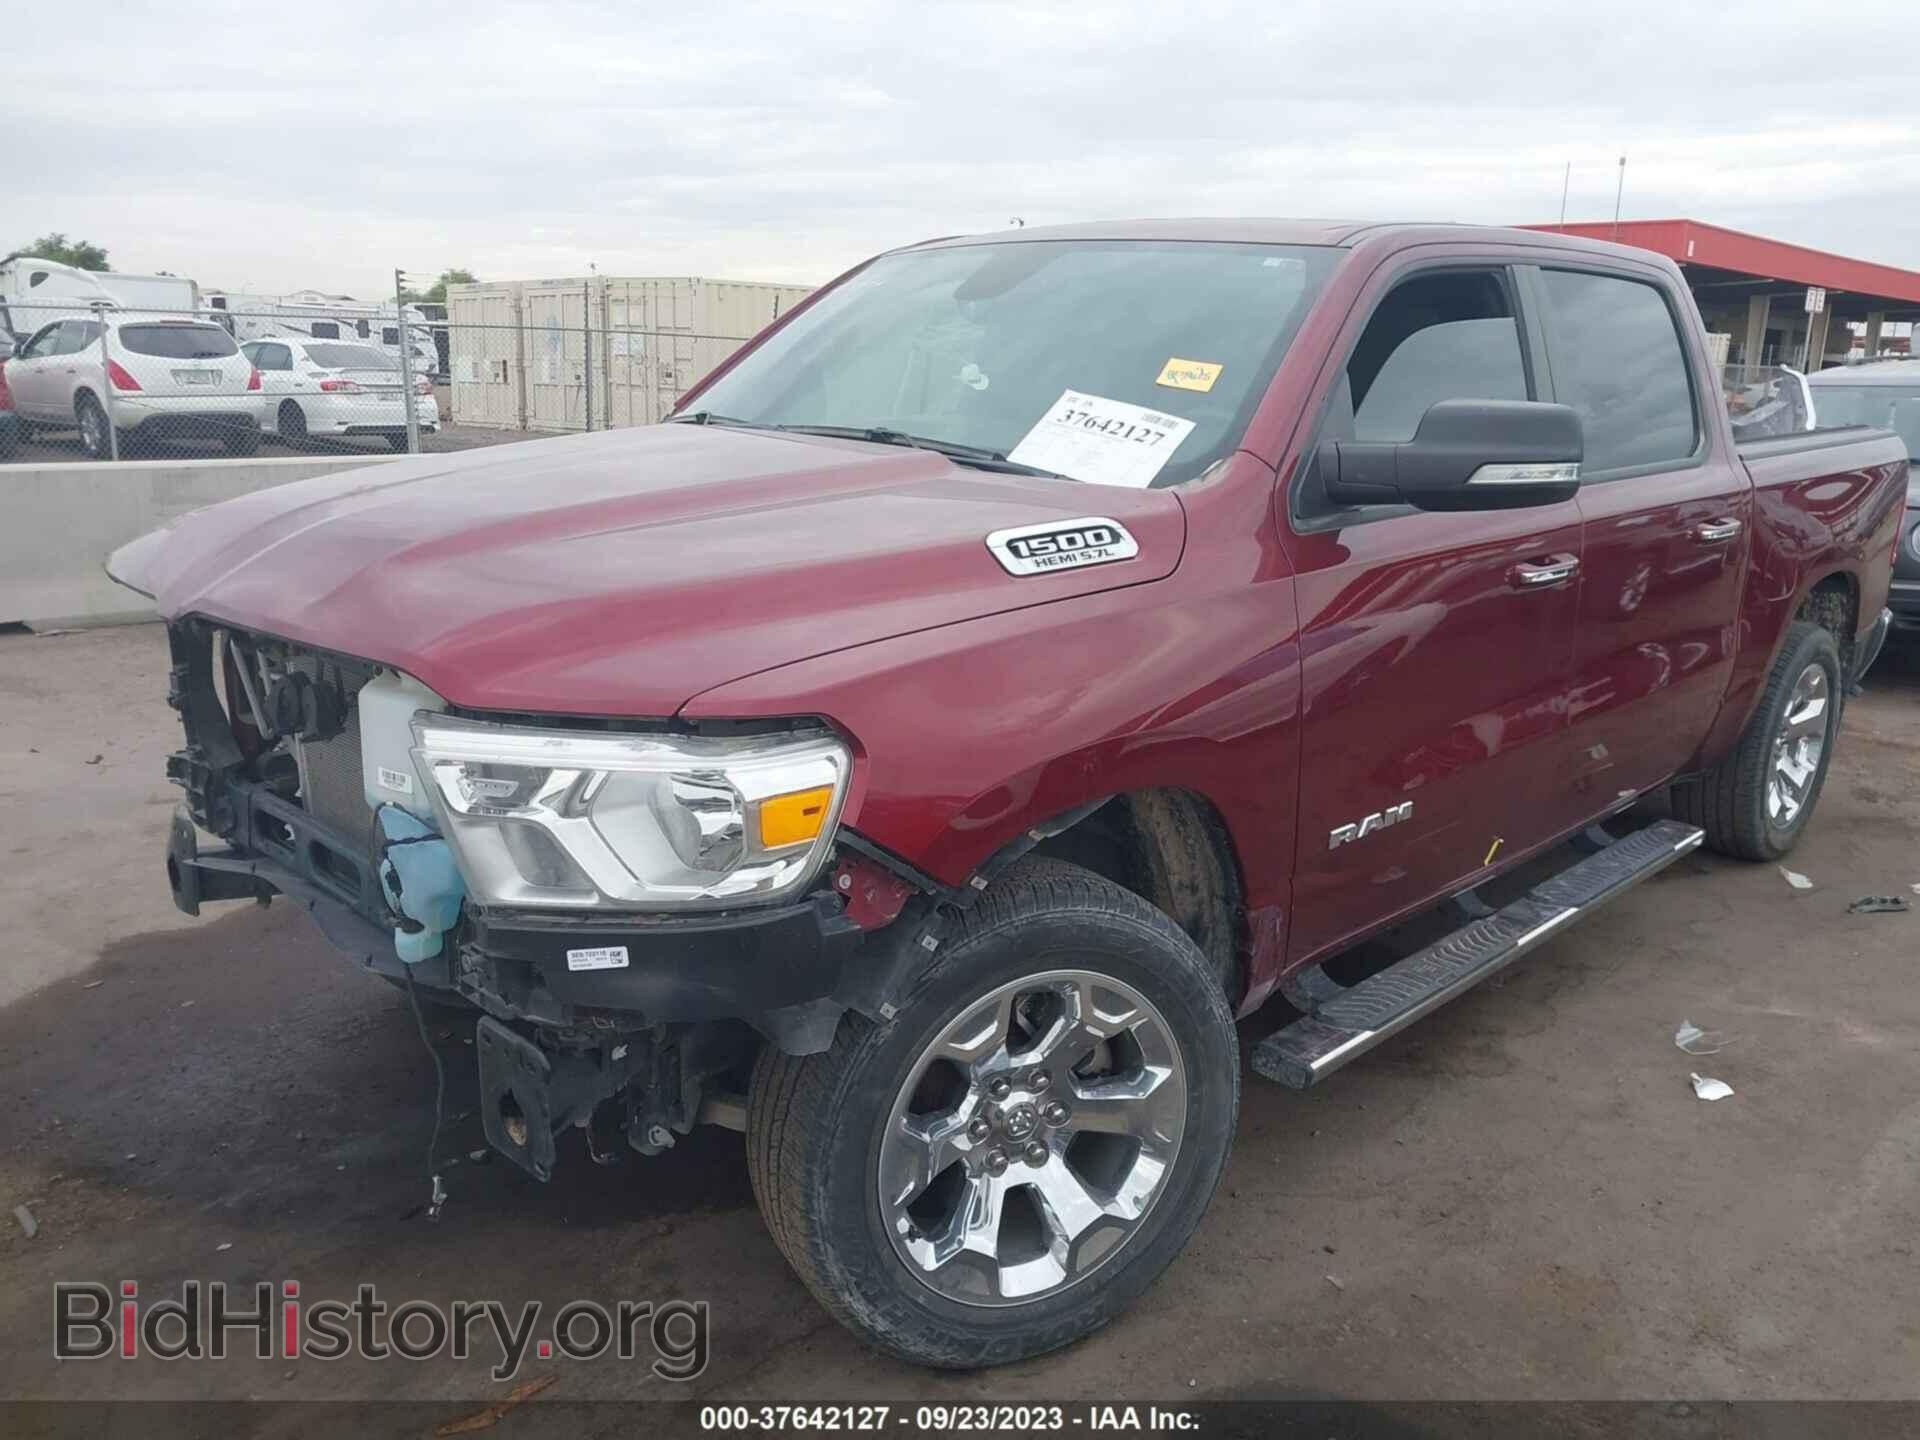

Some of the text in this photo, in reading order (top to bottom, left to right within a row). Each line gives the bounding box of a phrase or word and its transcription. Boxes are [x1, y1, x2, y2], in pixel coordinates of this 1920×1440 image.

[1056, 409, 1166, 446] 37642127
[1010, 527, 1113, 558] 1500
[1034, 548, 1116, 568] HEMI 5.7L
[1328, 800, 1413, 850] RAM
